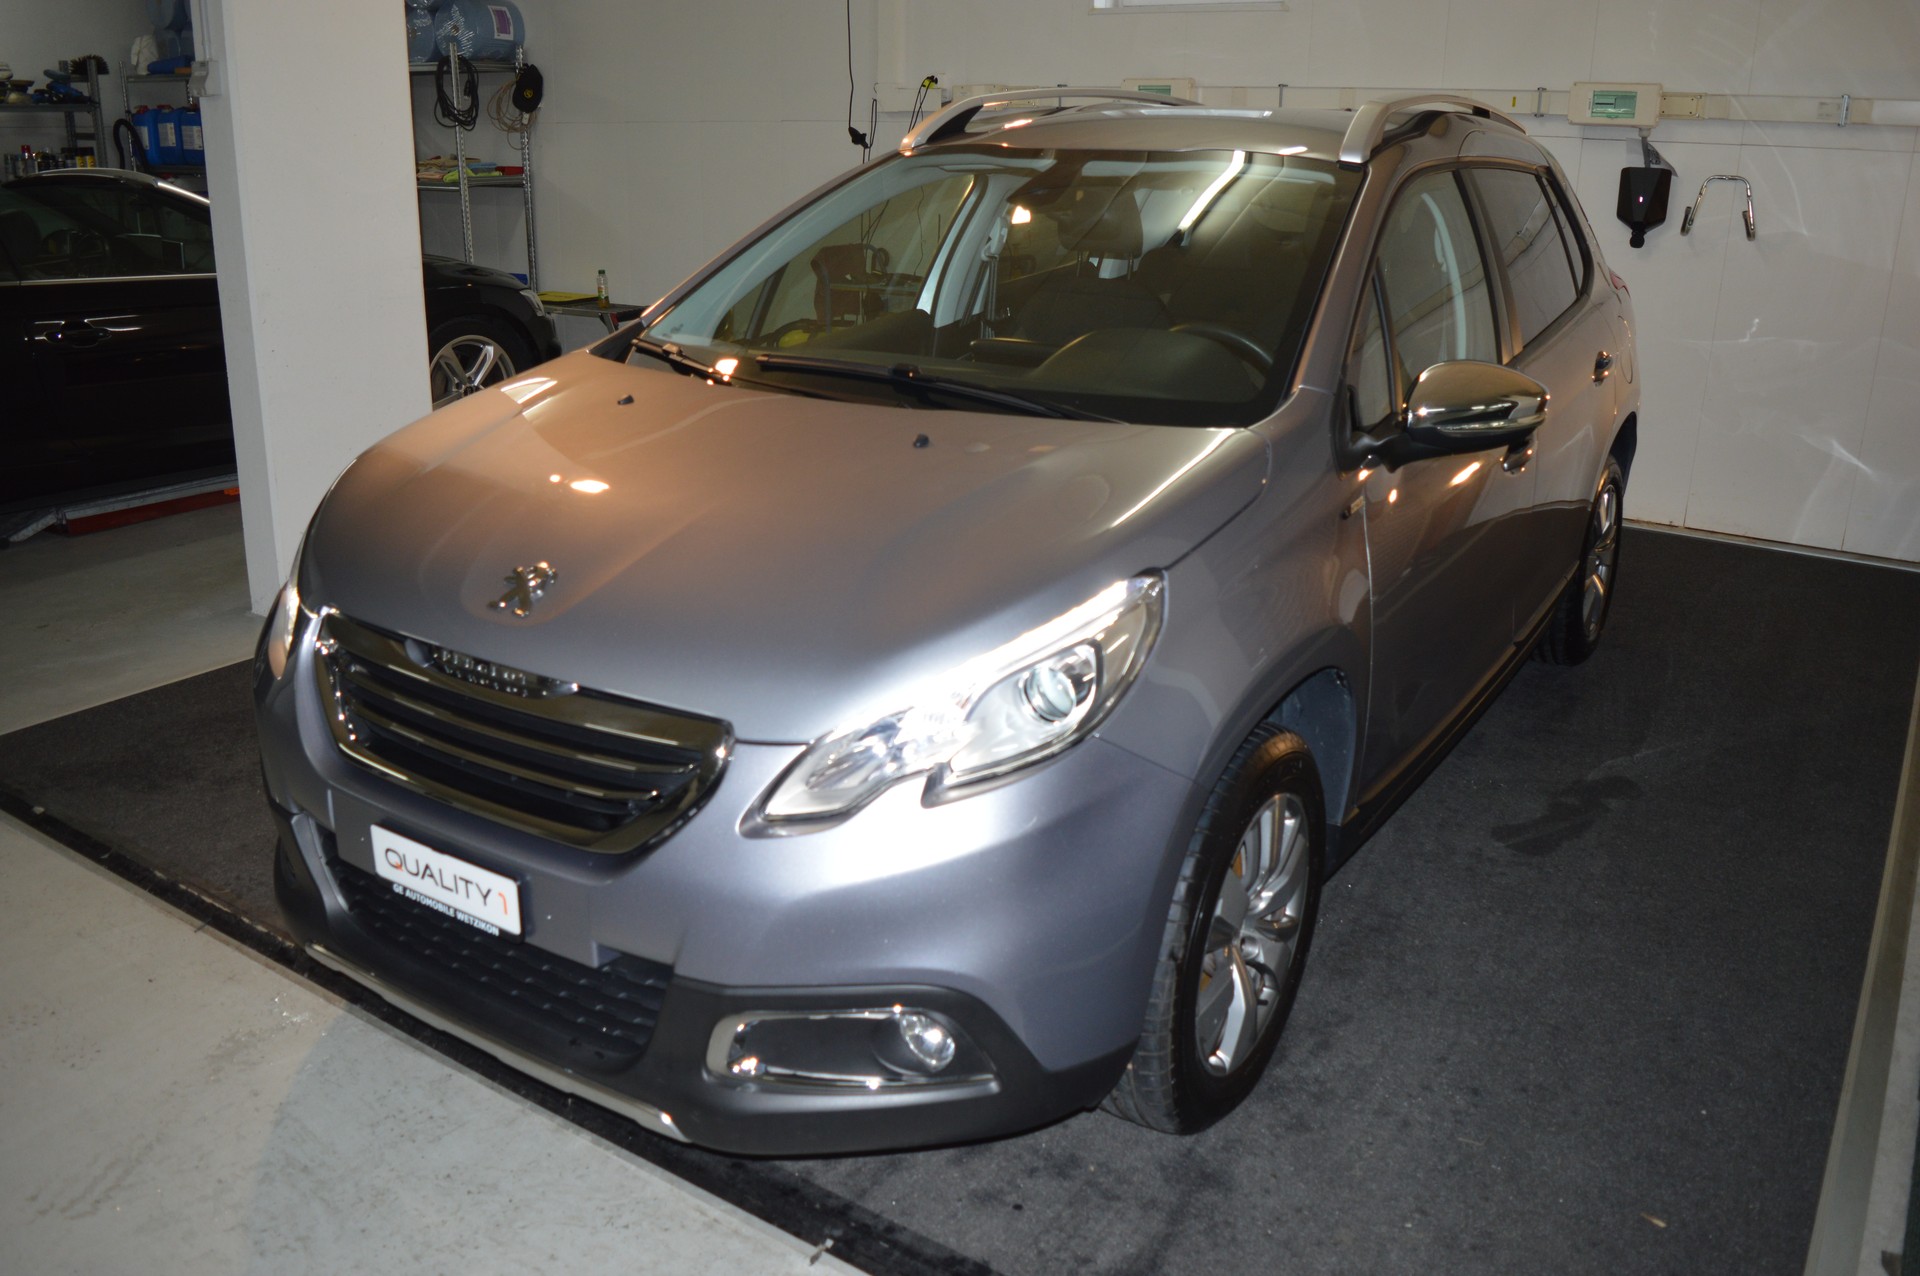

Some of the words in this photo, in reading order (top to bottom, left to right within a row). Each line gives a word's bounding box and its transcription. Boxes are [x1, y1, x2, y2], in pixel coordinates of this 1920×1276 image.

[385, 848, 492, 907] QUALITY
[405, 888, 455, 918] AUTOMOBILE
[456, 909, 500, 937] WETZIKON
